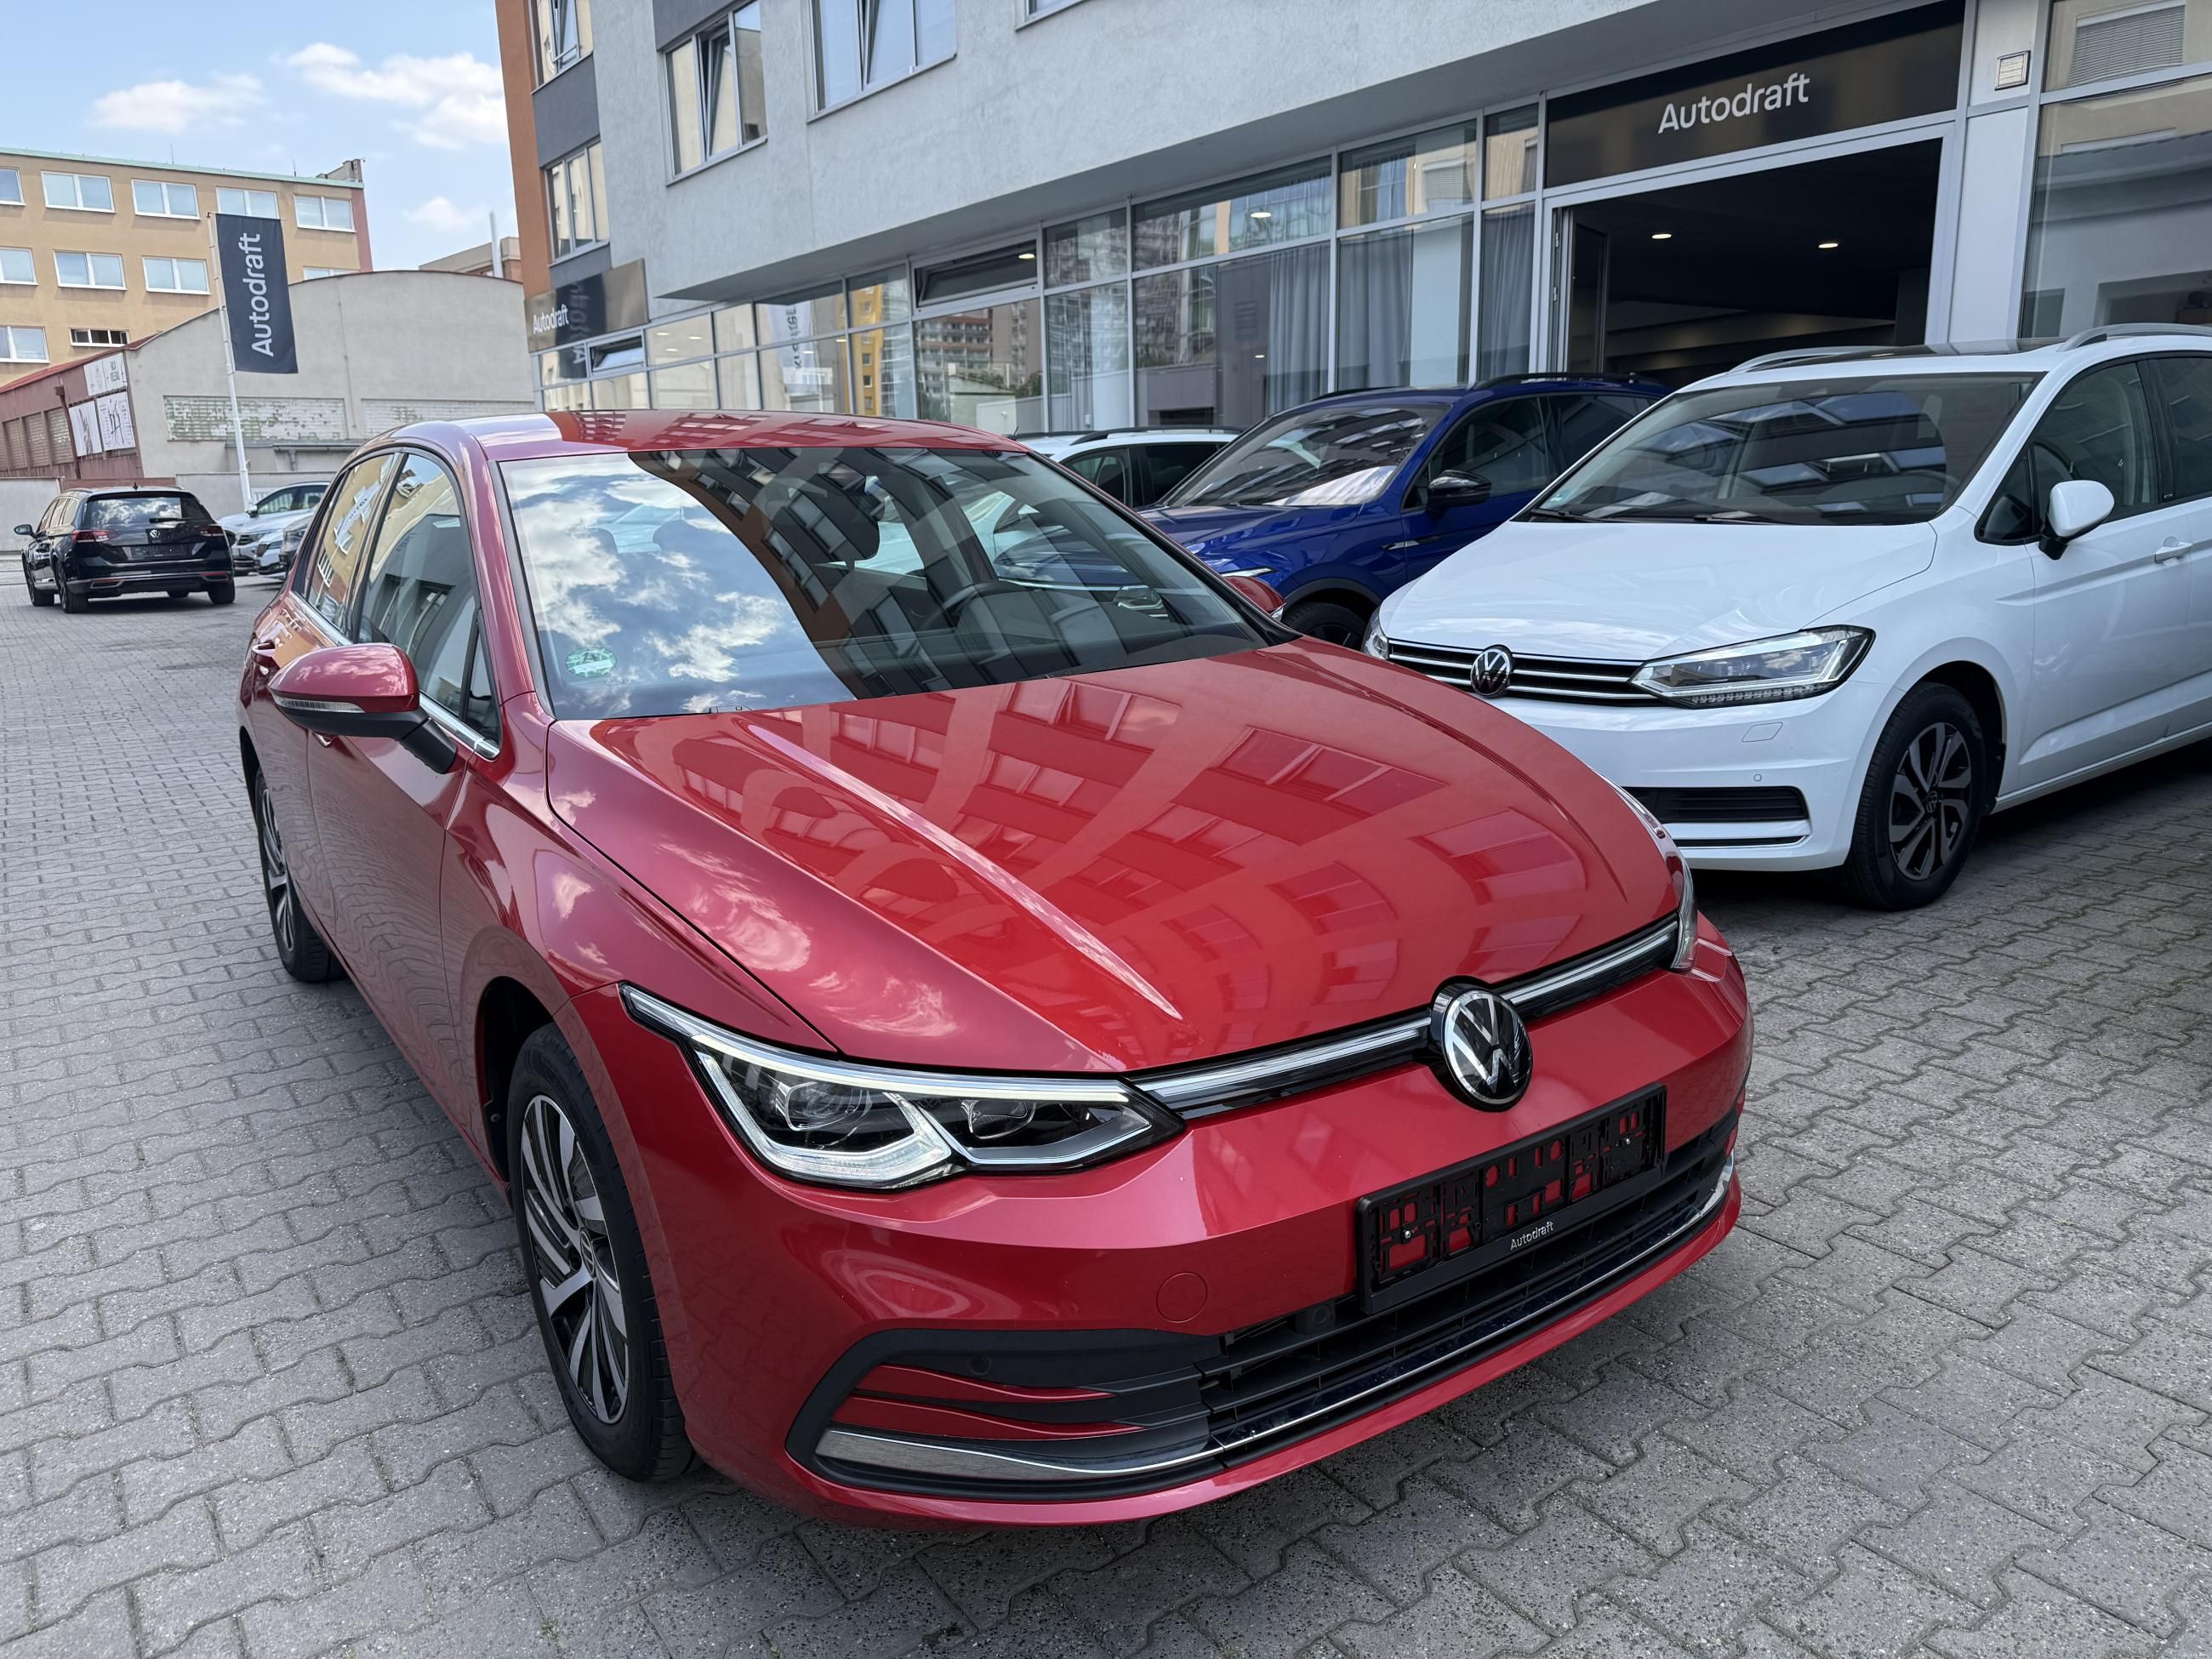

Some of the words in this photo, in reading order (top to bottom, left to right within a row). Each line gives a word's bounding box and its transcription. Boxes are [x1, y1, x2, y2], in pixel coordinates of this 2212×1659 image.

[1657, 71, 1810, 134] Autodraft
[238, 232, 274, 357] Autodraft
[533, 303, 570, 334] Autodraft
[1510, 1221, 1554, 1251] Autodraft
